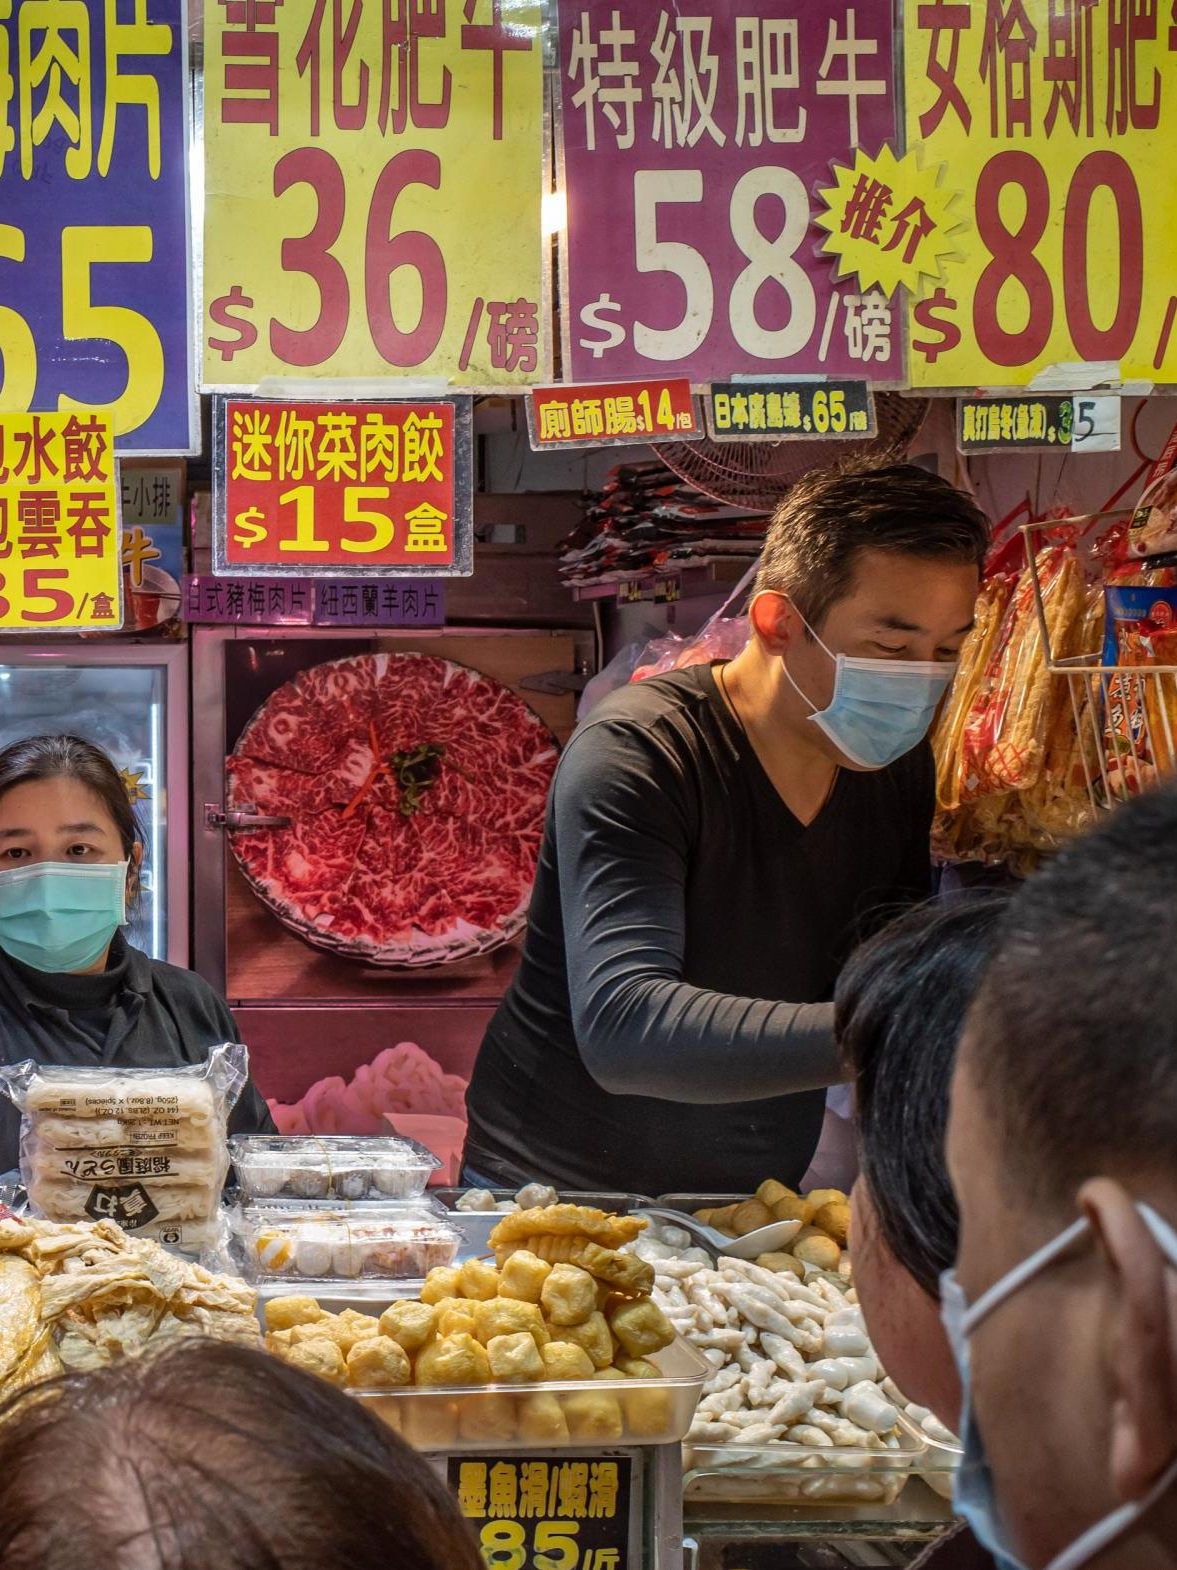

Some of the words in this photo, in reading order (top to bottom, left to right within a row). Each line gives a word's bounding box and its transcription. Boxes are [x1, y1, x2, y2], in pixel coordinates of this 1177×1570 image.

[568, 12, 887, 151] 特級肥牛
[840, 173, 938, 265] 推介
[232, 411, 445, 484] 迷你菜肉餃
[188, 583, 307, 616] 日式豬梅肉片
[321, 584, 439, 617] 紐西蘭羊肉片
[93, 1189, 147, 1218] 真打
